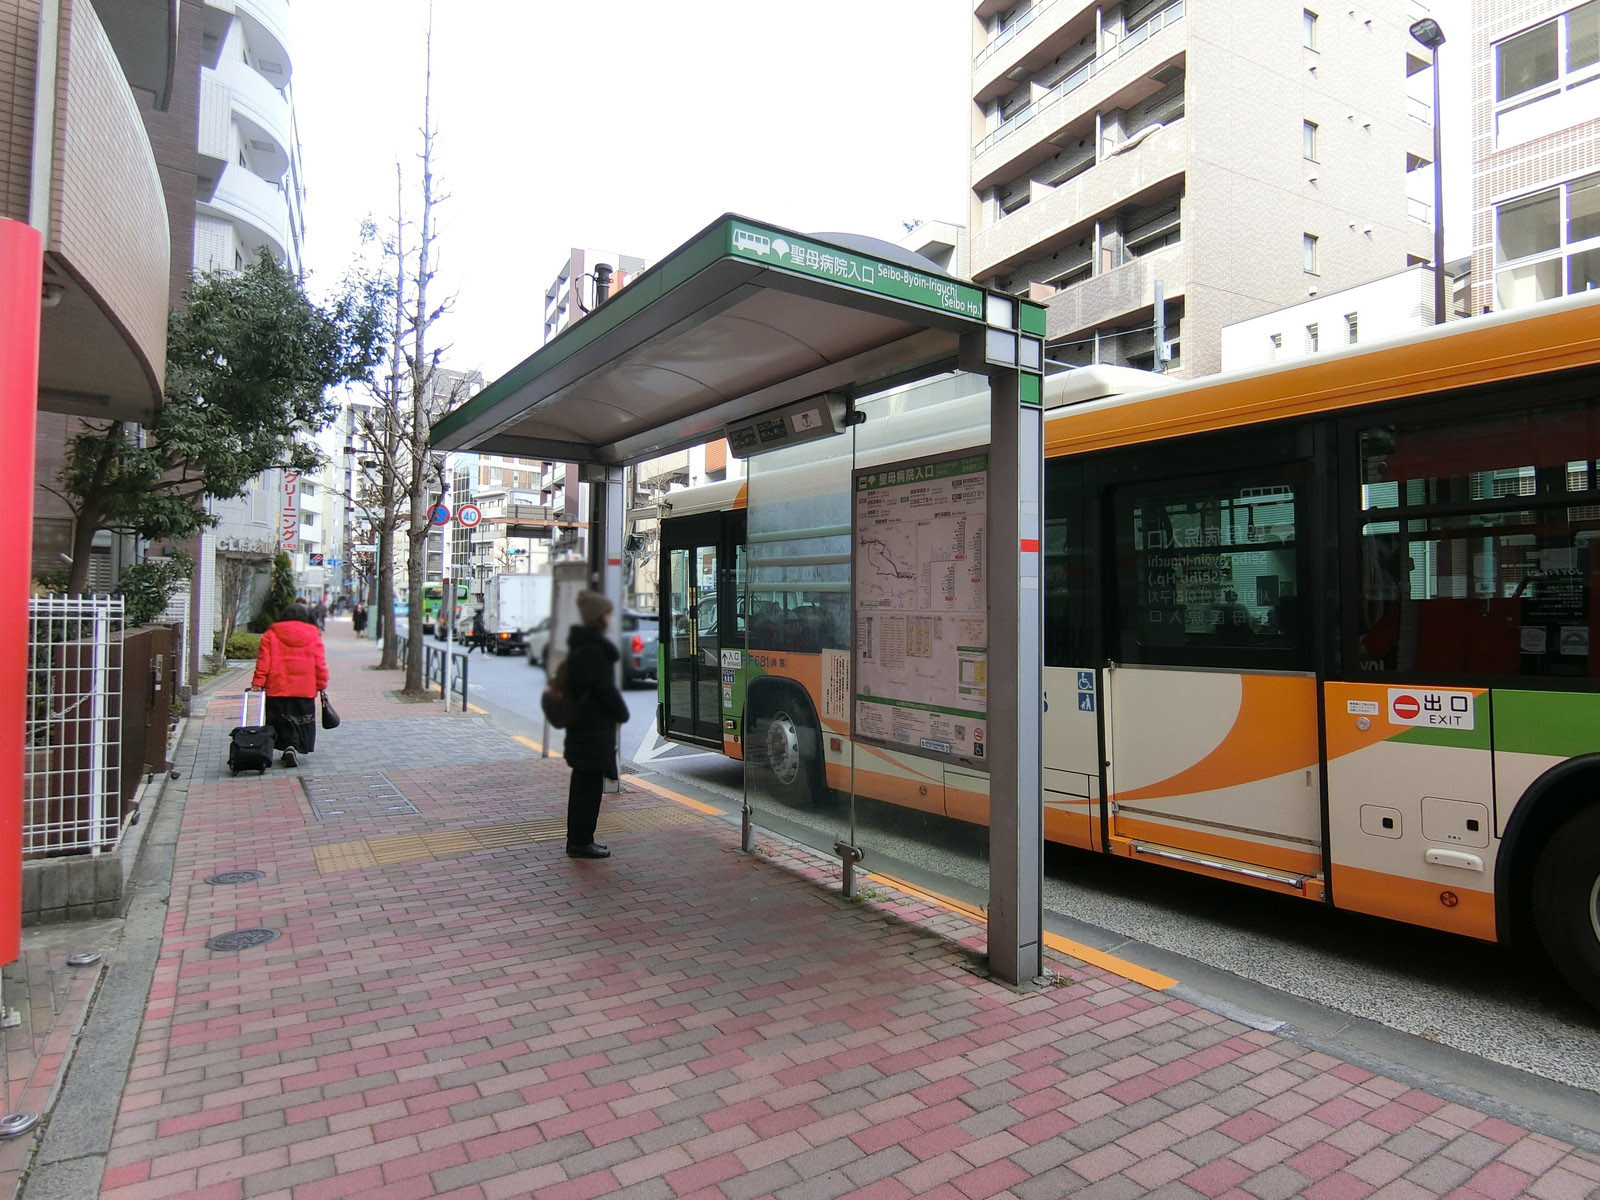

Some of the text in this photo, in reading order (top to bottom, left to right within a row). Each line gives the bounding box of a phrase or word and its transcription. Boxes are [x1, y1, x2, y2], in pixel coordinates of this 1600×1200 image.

[790, 243, 875, 285] 聖母病院入口
[941, 293, 983, 317] (Seibo Hp.)
[879, 465, 934, 486] 聖母病院入口
[282, 471, 298, 541] クリーニング
[463, 511, 477, 522] 40
[728, 651, 739, 661] 入口
[1423, 693, 1468, 712] 出口
[1429, 714, 1462, 726] EXIT
